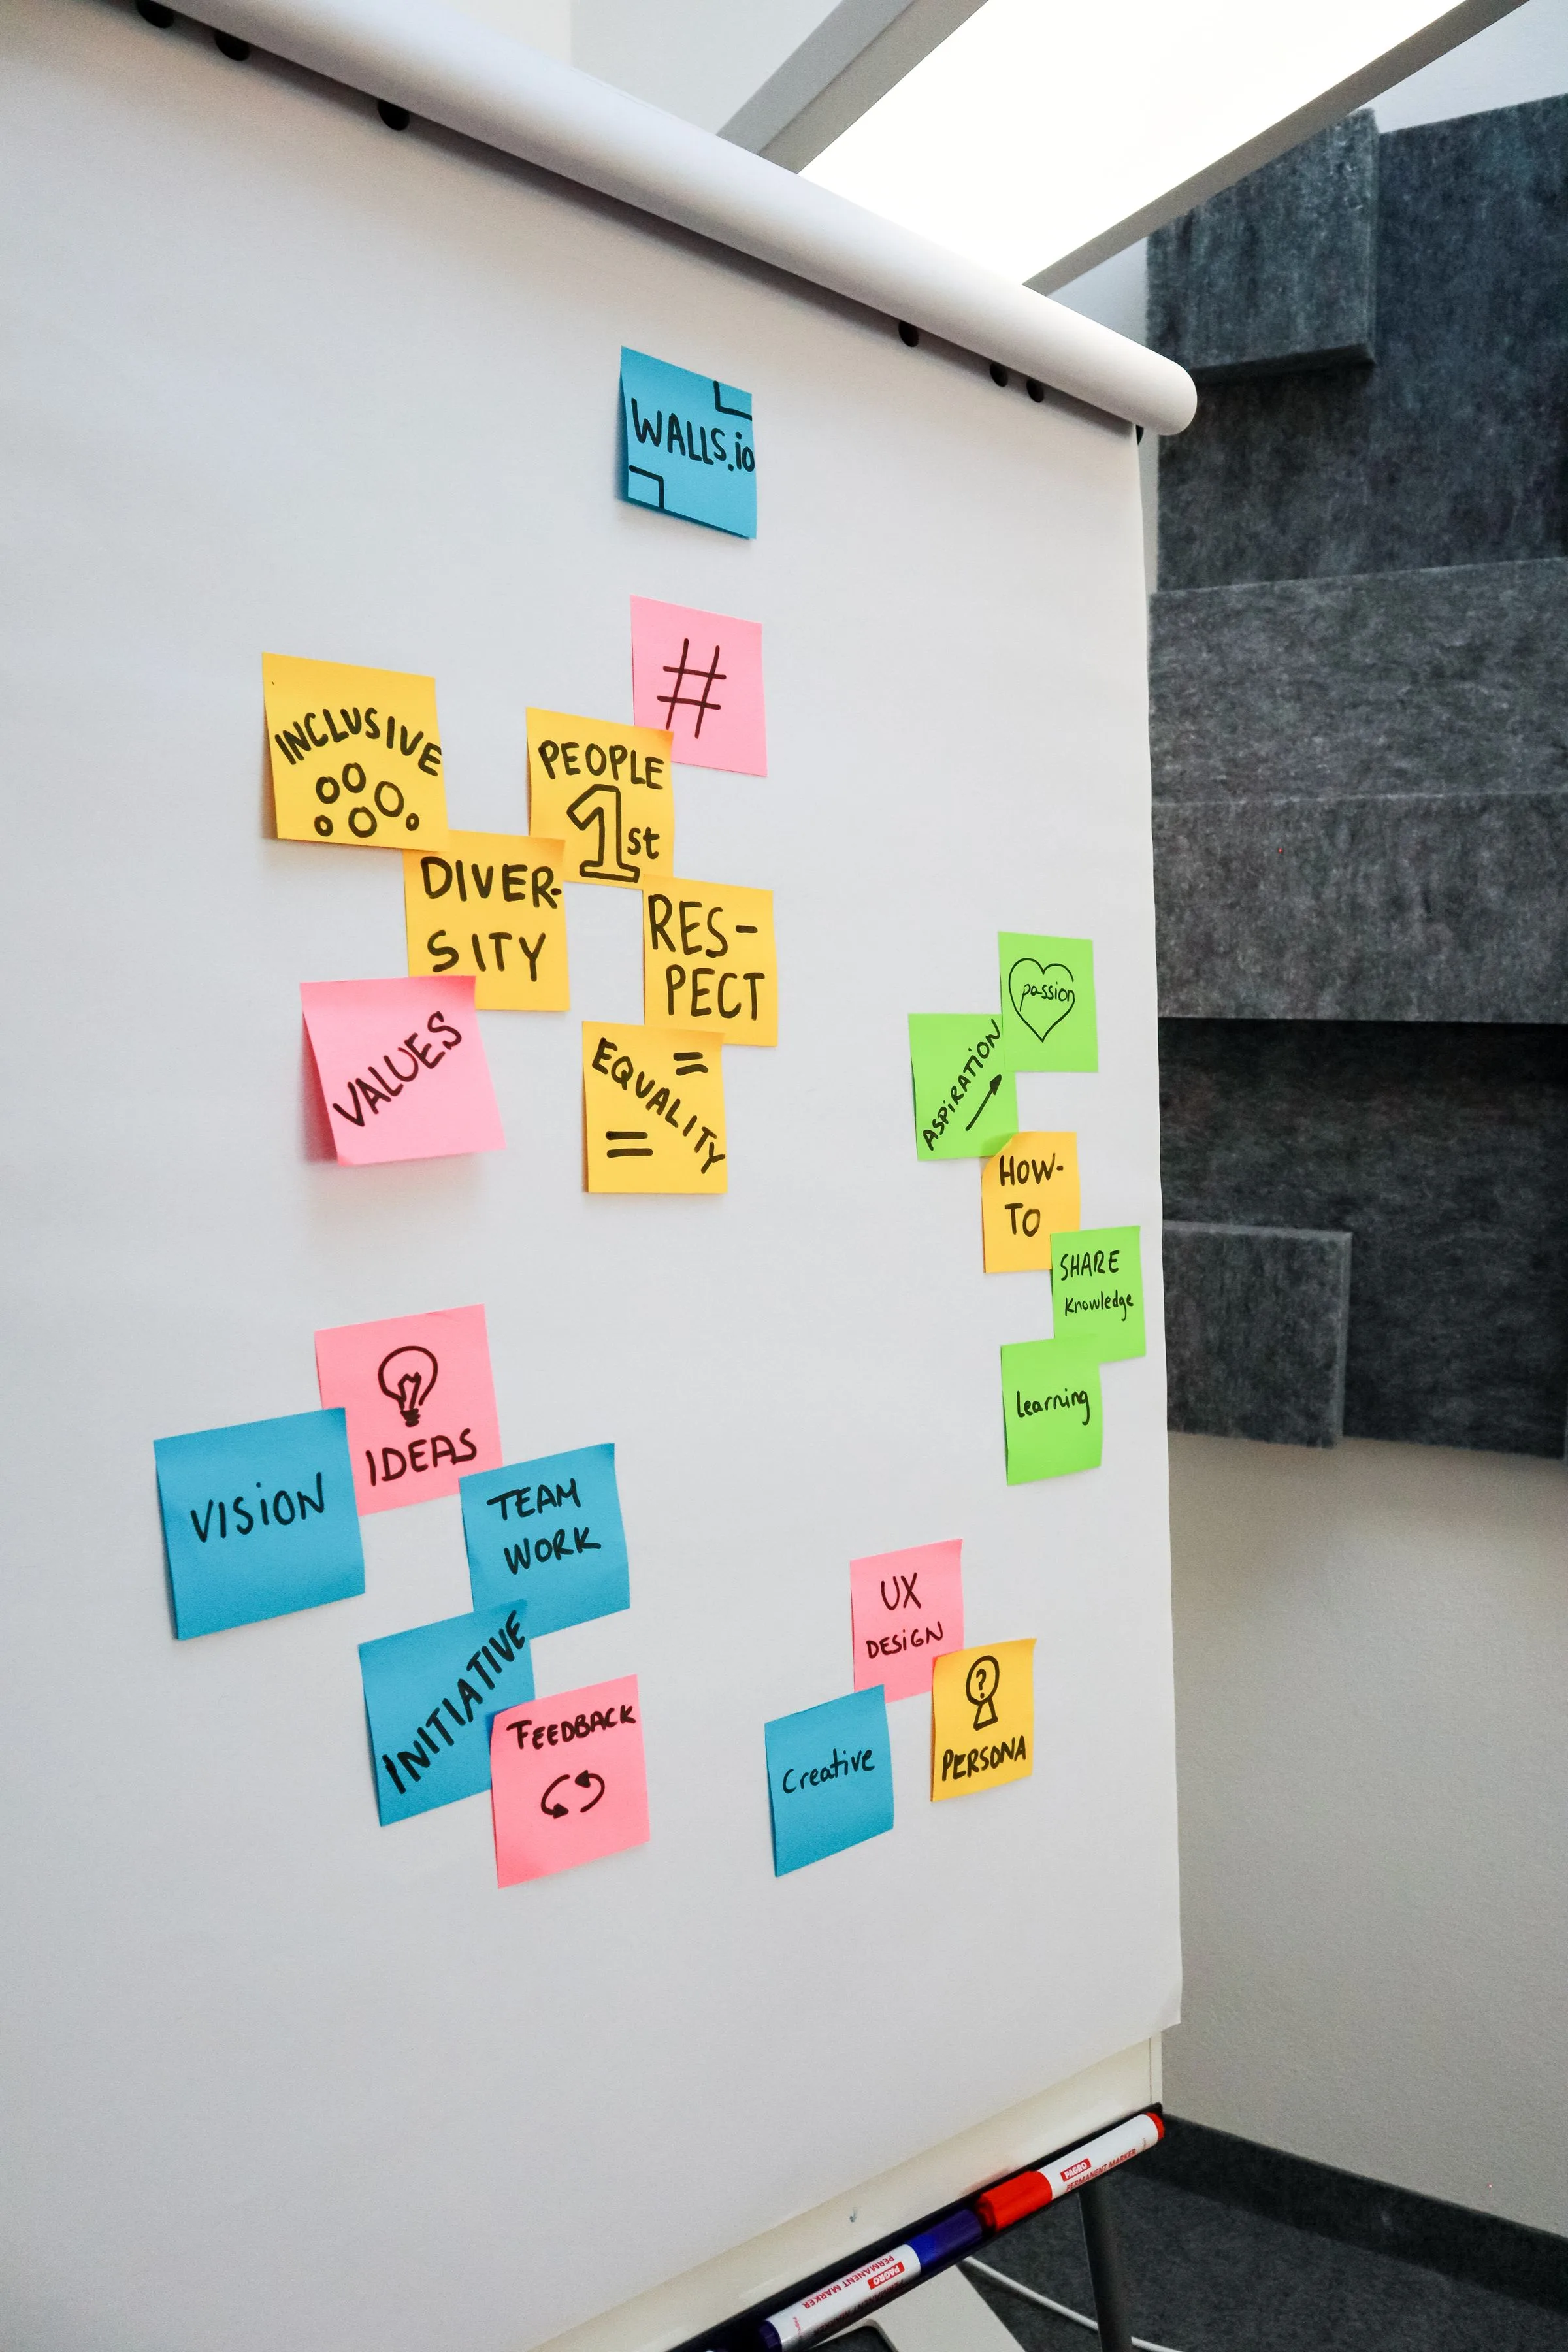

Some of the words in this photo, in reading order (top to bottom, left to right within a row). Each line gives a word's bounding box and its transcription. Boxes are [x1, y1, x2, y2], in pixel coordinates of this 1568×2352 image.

[630, 397, 755, 472] WALLS.io
[274, 706, 443, 777] INCLUSIVE
[538, 739, 665, 791] PEOPLE
[565, 783, 661, 884] 1st
[647, 894, 759, 959] RES-
[426, 930, 547, 983] SITY
[664, 964, 766, 1022] PECT
[1018, 981, 1076, 1015] passion
[332, 1009, 463, 1128] VALUES
[591, 1036, 726, 1175] EQUALITY
[998, 1152, 1066, 1188] HOW-
[1004, 1200, 1042, 1238] TO
[1058, 1249, 1121, 1282] SHARE
[365, 1427, 479, 1487] IDEAS
[485, 1477, 582, 1522] TEAM
[502, 1526, 602, 1576] WORK
[880, 1571, 921, 1611] UX
[380, 1609, 526, 1796] INITIATIVE
[506, 1703, 637, 1751] FEEDBACK
[781, 1748, 876, 1795] Creative
[941, 1735, 1027, 1782] PERSONA
[1064, 2161, 1088, 2180] PAGRO
[1066, 2164, 1108, 2192] PERMANENT
[1109, 2148, 1136, 2167] MARKER
[843, 2255, 894, 2288] PERMANENT
[872, 2266, 901, 2285] PAGRO
[801, 2284, 841, 2309] MARKER
